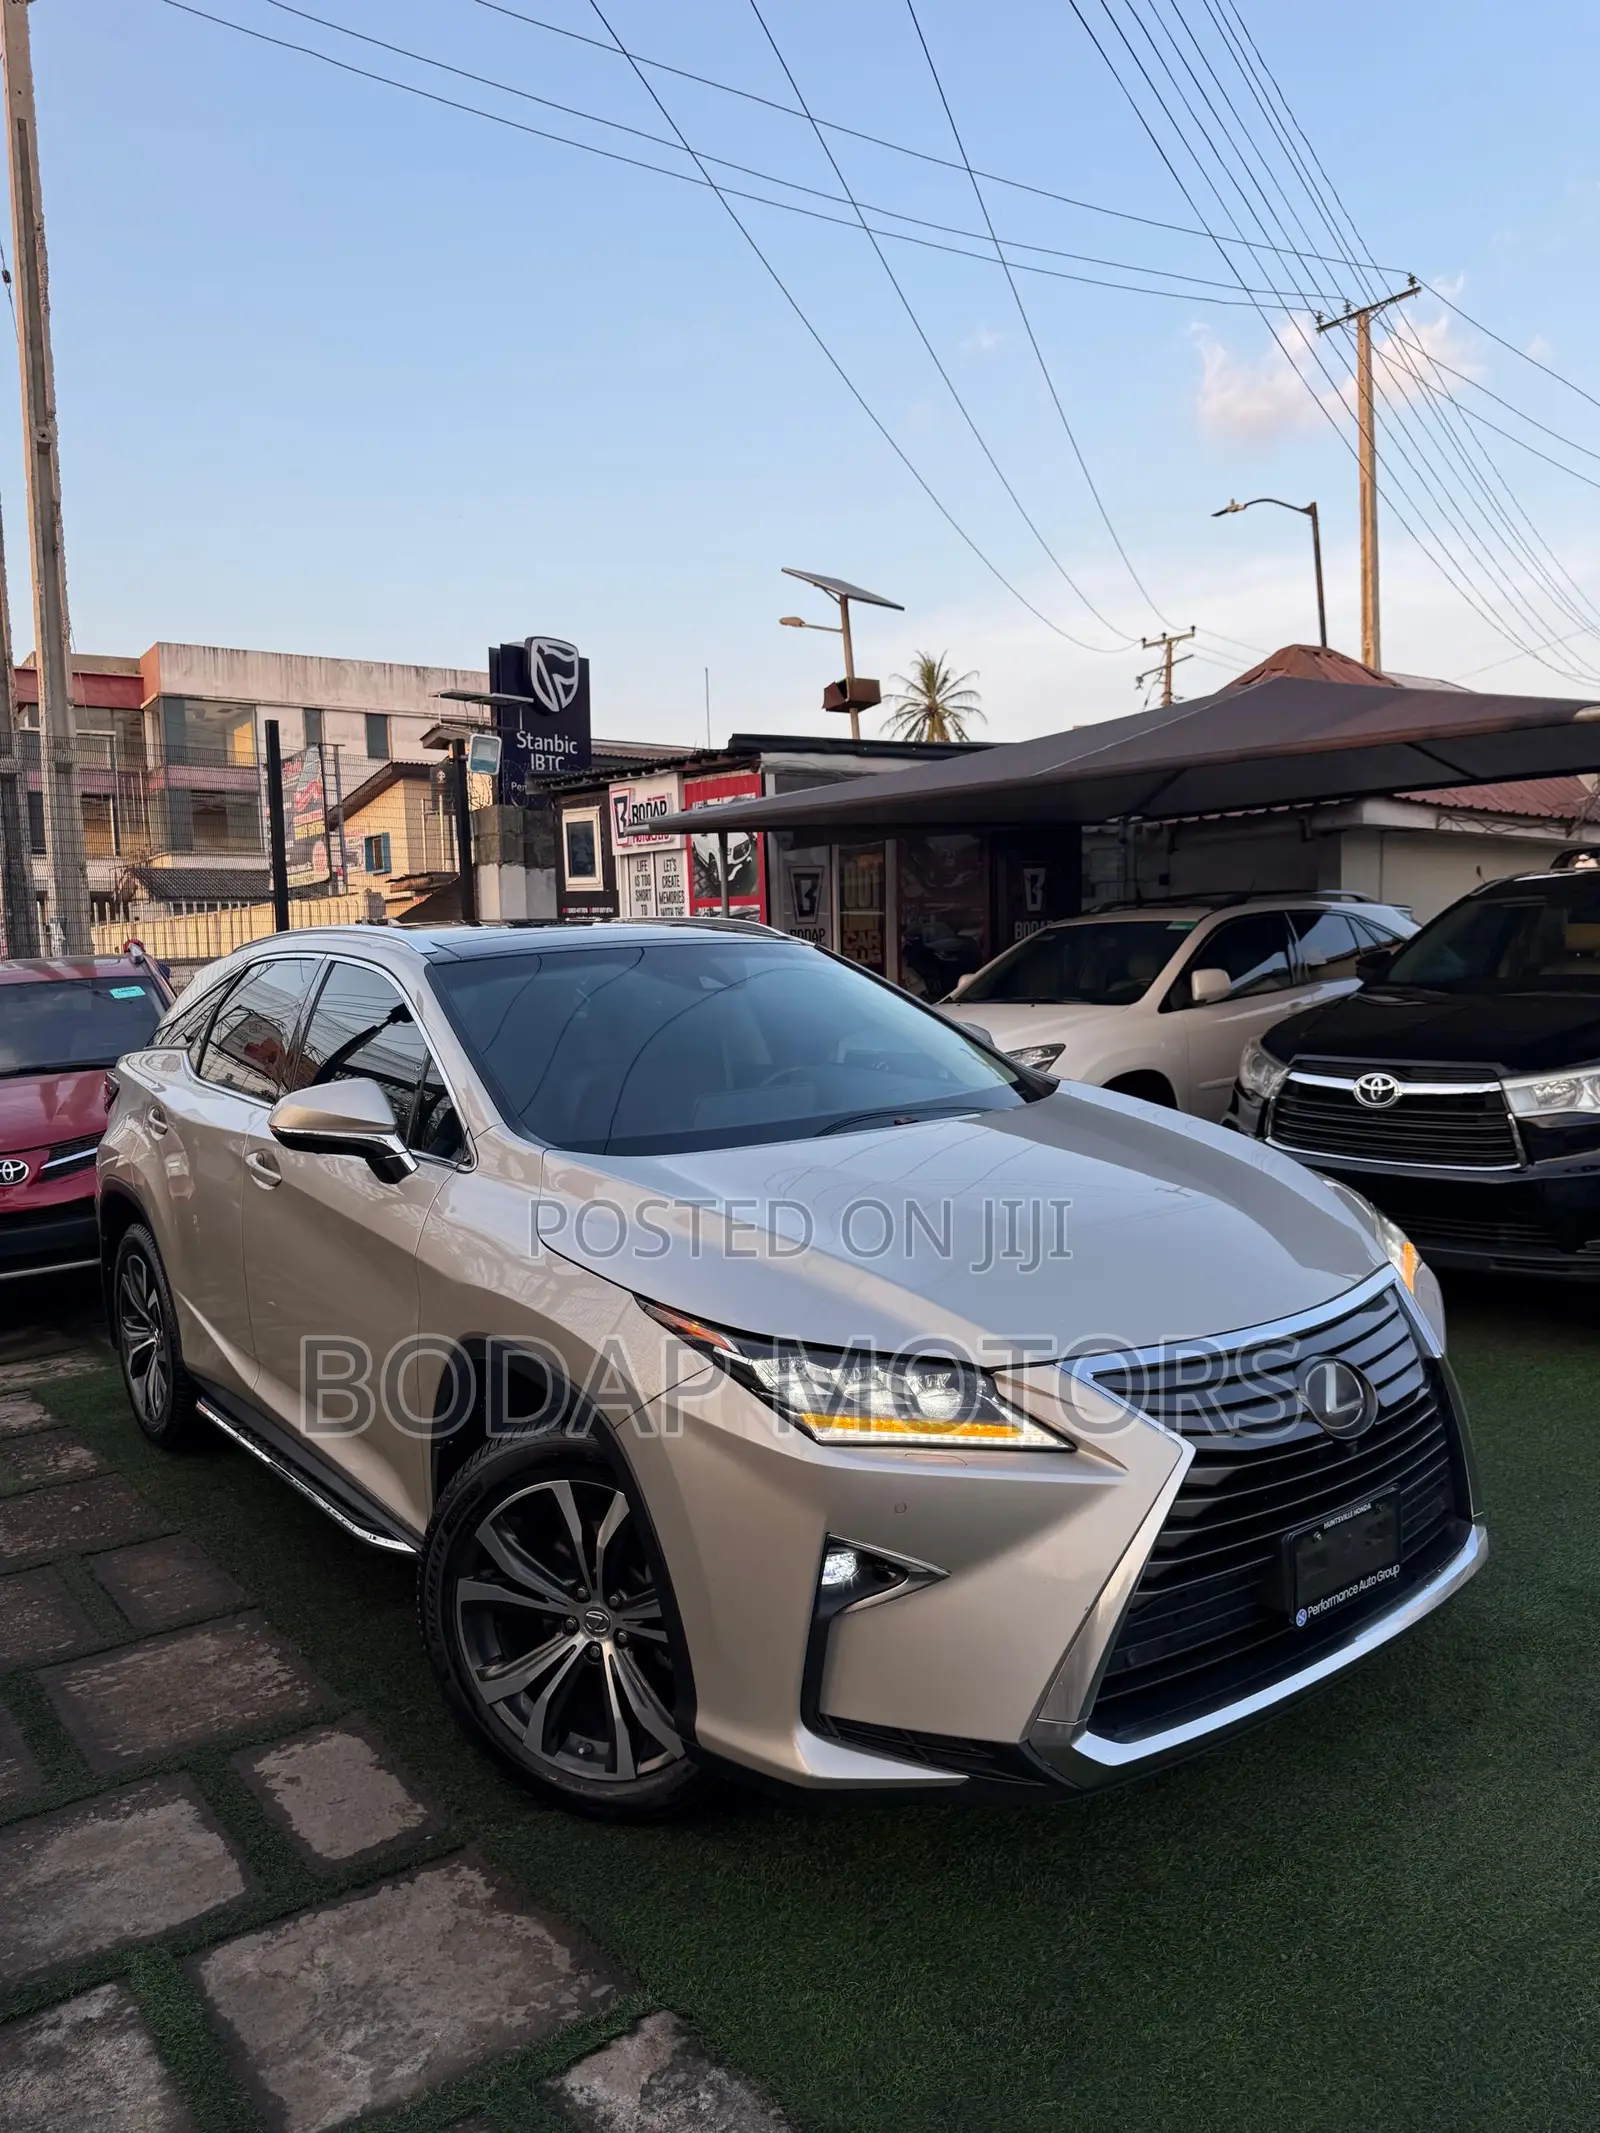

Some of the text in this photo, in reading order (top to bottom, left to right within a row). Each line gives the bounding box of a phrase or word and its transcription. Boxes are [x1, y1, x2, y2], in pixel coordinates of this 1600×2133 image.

[516, 730, 578, 755] Stanbic
[530, 752, 565, 772] IBTC
[632, 800, 667, 826] BODAP
[637, 860, 648, 872] LIFE
[663, 857, 677, 872] LET'S
[635, 874, 651, 887] IS TOO
[662, 875, 680, 888] CREATE
[635, 889, 651, 902] SHORT
[658, 890, 685, 904] MEMORIES
[641, 904, 648, 916] TO
[1323, 1502, 1372, 1530] HUNTSVILLE HONDA
[1307, 1564, 1401, 1618] Performance Auto Group
